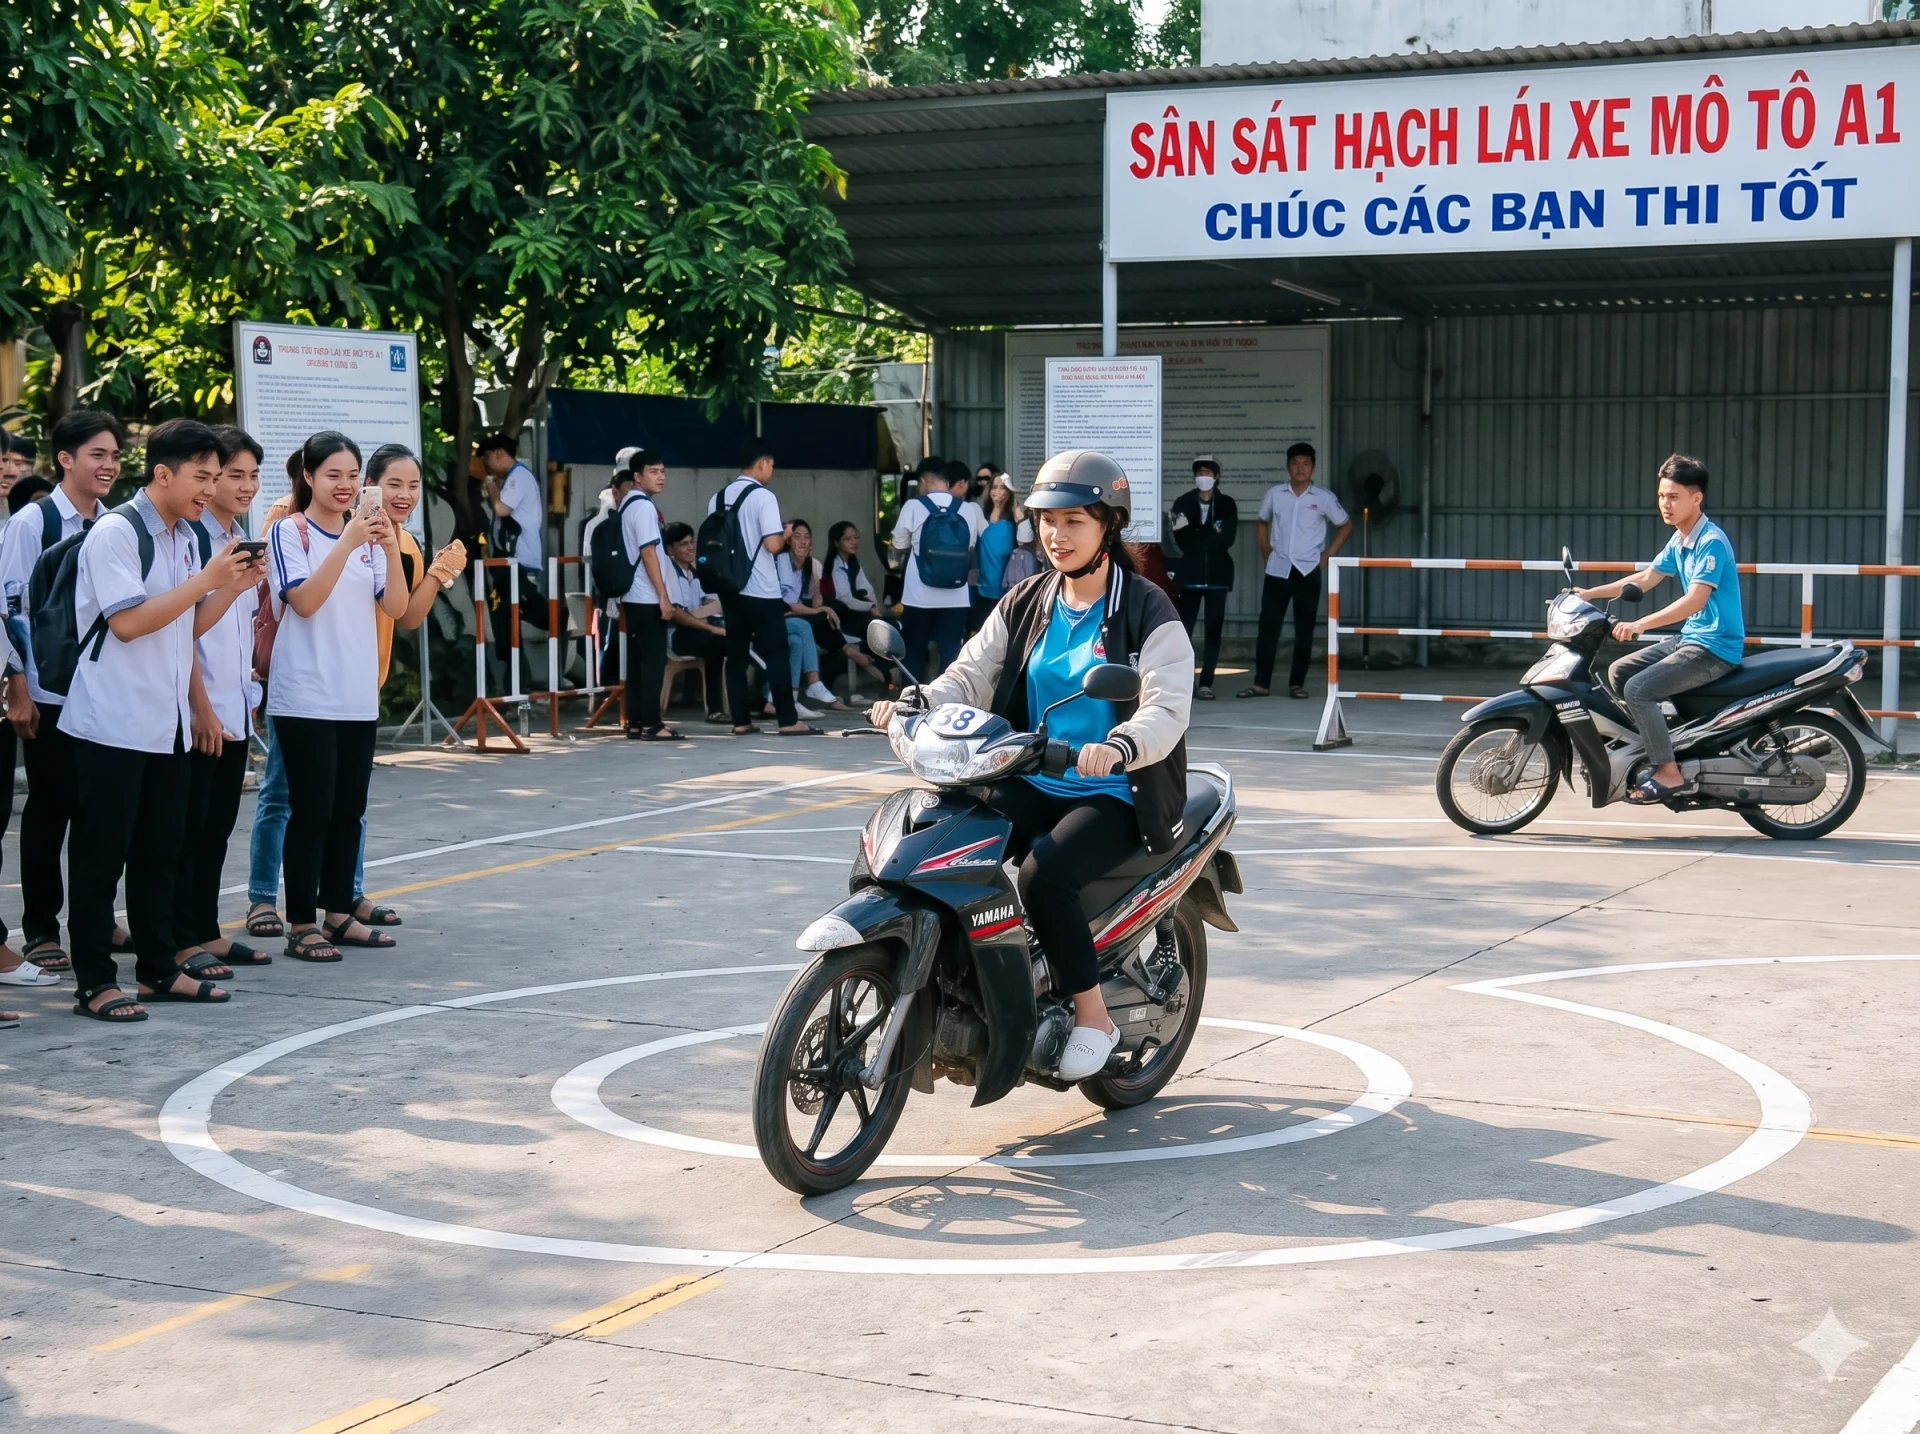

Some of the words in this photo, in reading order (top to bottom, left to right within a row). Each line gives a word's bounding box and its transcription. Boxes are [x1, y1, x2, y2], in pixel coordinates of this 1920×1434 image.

[1129, 105, 1215, 180] SÂN
[1231, 99, 1317, 175] SÁT
[1334, 107, 1458, 183] HẠCH
[1477, 85, 1551, 164] LÁI
[1567, 97, 1631, 160] XE
[1650, 74, 1730, 156] MÔ
[1747, 69, 1816, 150] TÔ
[1834, 81, 1901, 146] A1
[1204, 189, 1346, 242] CHÚC
[1364, 184, 1471, 237] CÁC
[1491, 189, 1605, 240] BẠN
[1624, 184, 1719, 227] THI
[1740, 161, 1858, 223] TỐT
[376, 351, 383, 359] A1
[938, 707, 976, 731] 38
[972, 904, 1014, 927] YAMAHA
